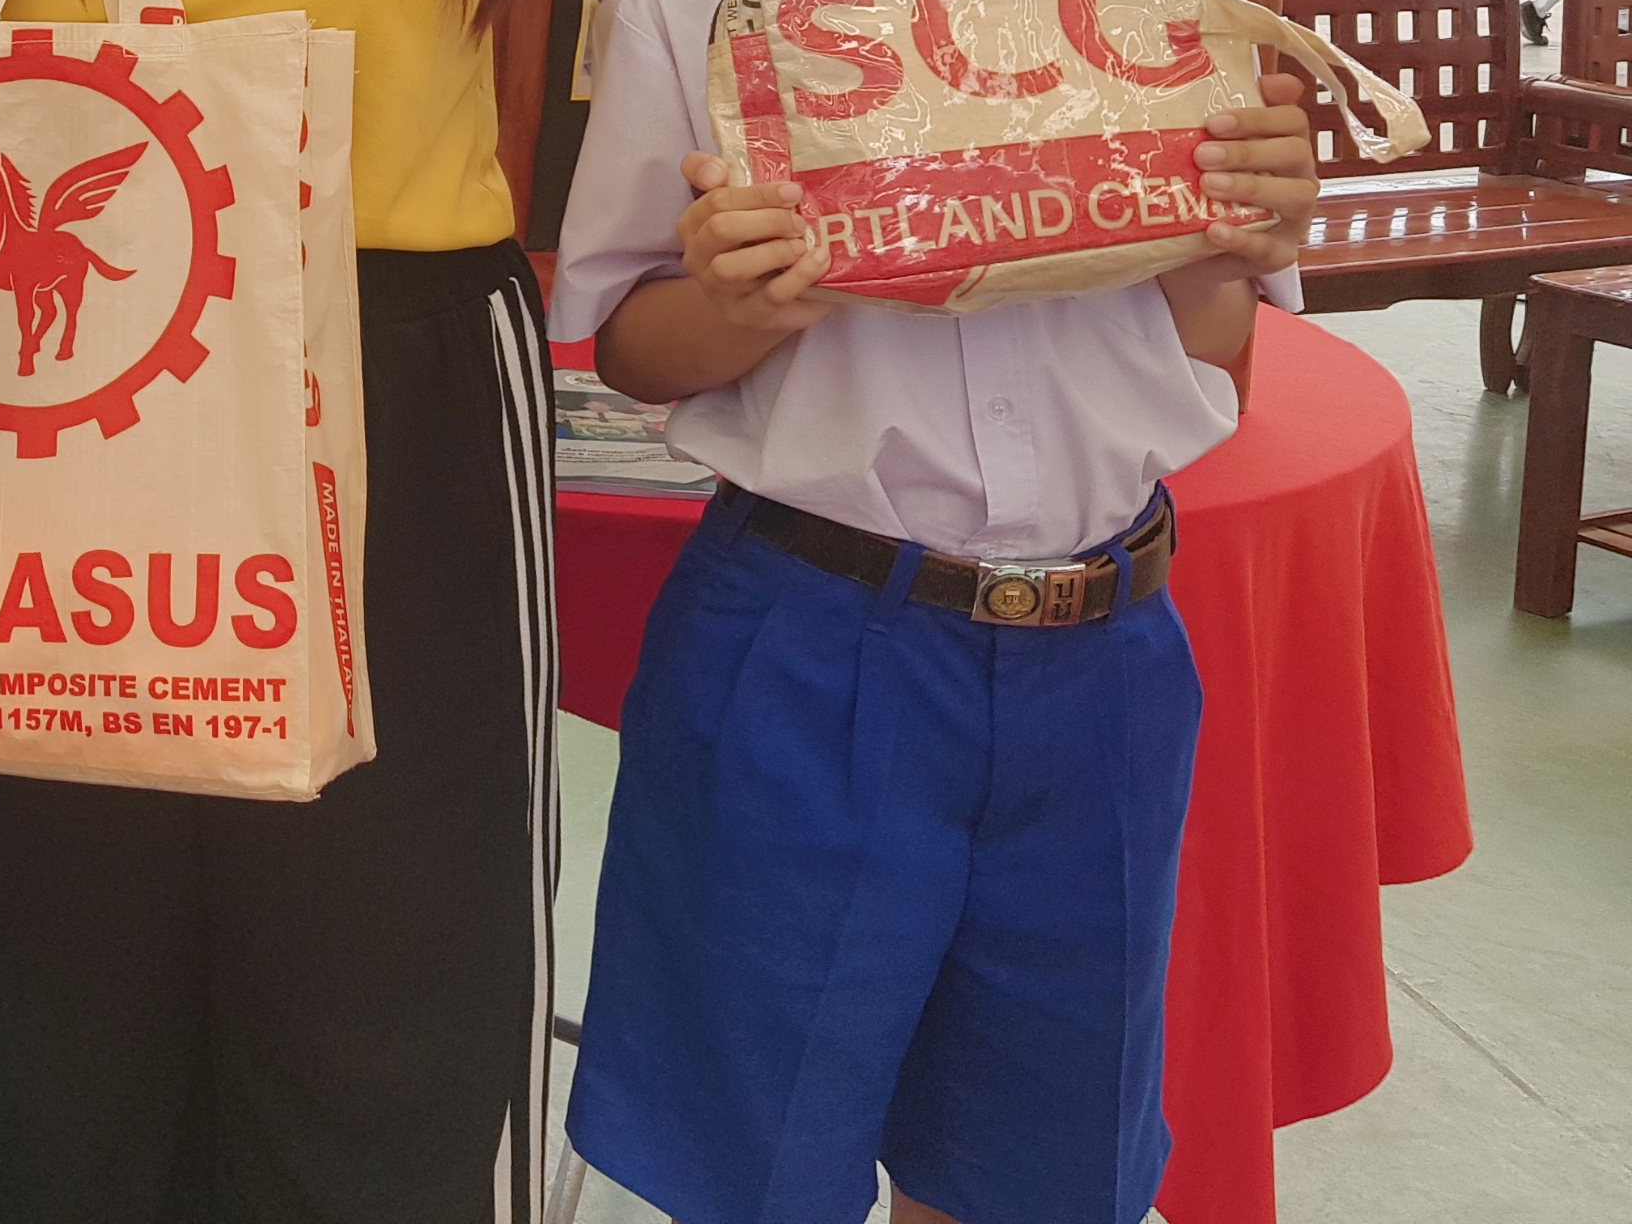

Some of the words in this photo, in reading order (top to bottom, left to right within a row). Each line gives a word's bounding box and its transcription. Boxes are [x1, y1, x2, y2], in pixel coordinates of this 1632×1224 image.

[806, 188, 1074, 258] RTLAND
[321, 481, 339, 554] MADE
[330, 561, 342, 588] IN
[147, 676, 288, 704] CEMENT
[102, 709, 144, 736] BS
[153, 712, 196, 738] EN
[205, 713, 289, 740] 197-1
